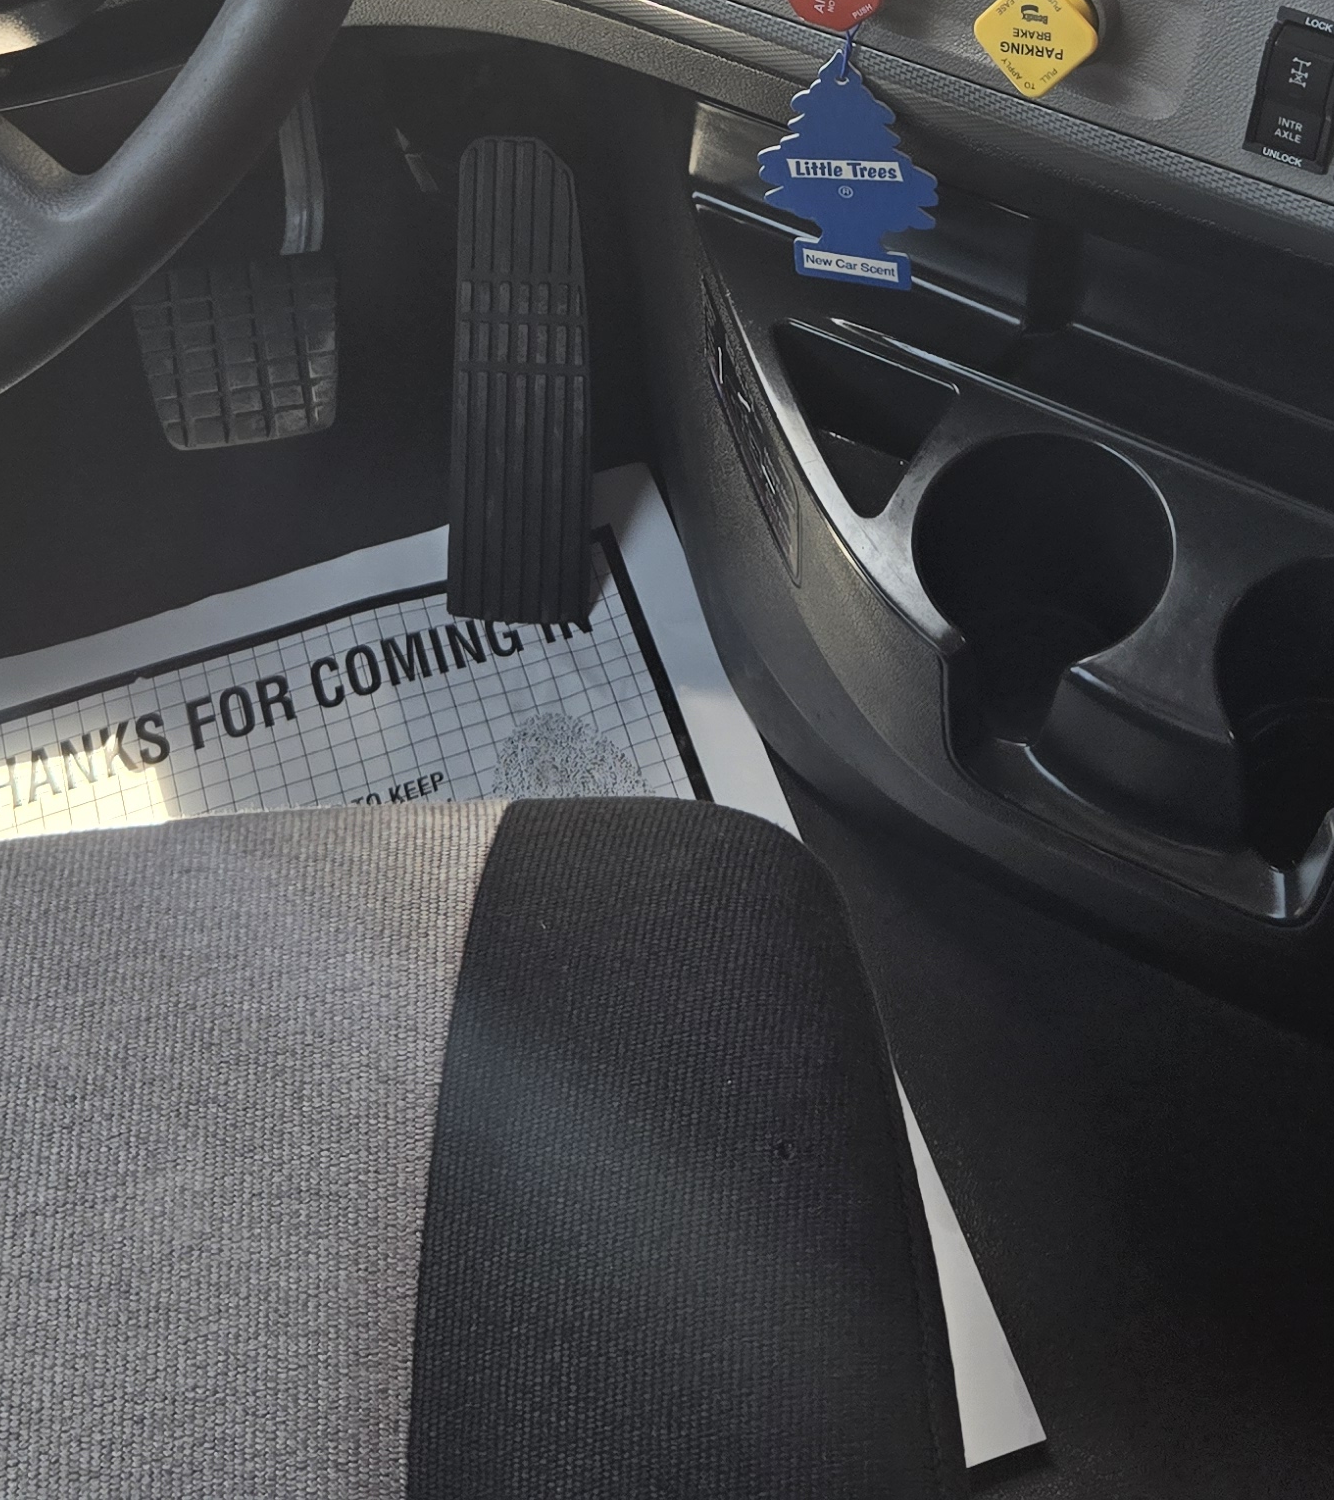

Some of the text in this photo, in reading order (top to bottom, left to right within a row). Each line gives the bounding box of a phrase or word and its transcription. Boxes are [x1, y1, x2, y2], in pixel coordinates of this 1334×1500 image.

[852, 3, 873, 19] PUSH
[1304, 16, 1334, 33] LOCK
[1012, 27, 1052, 42] BRAKE
[1000, 41, 1064, 61] PARKING
[1001, 58, 1058, 90] PULL TO APPLY
[1278, 116, 1303, 132] INTR
[1274, 128, 1303, 145] AXLE
[1262, 146, 1303, 168] UNLOCK
[795, 160, 898, 179] Little Trees
[805, 254, 896, 277] New Car Scent
[186, 674, 297, 751] FOR
[310, 620, 525, 708] COMING
[388, 770, 445, 804] KEEP
